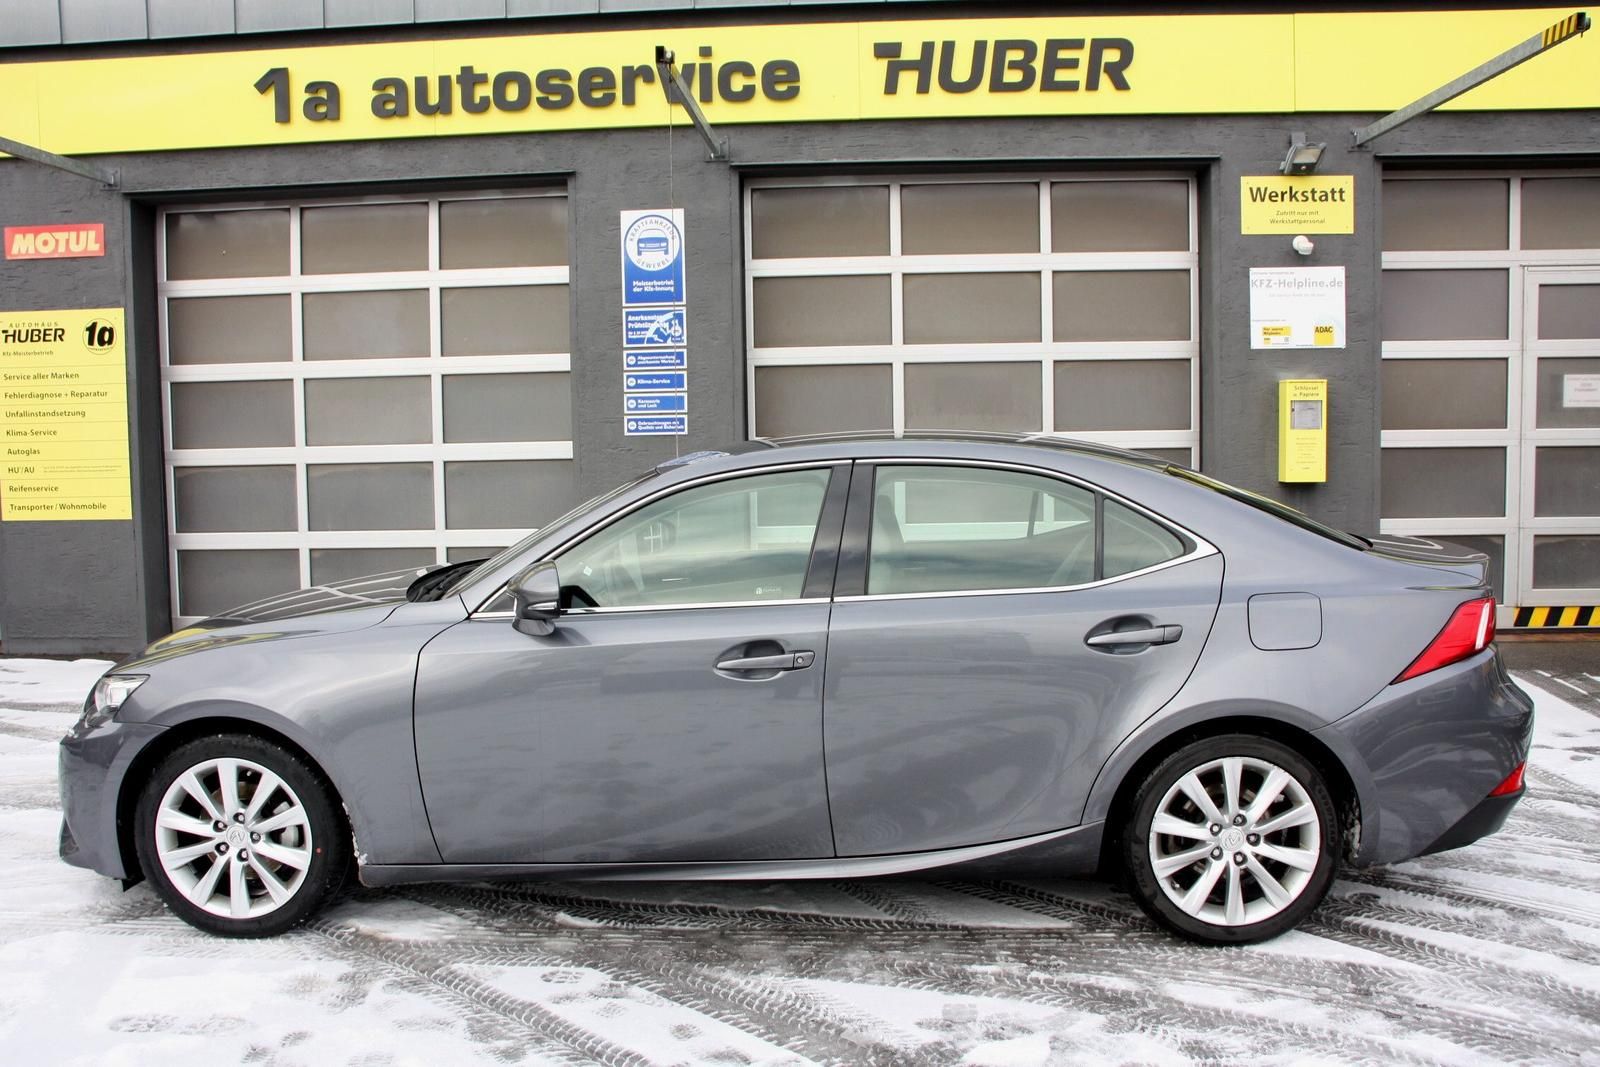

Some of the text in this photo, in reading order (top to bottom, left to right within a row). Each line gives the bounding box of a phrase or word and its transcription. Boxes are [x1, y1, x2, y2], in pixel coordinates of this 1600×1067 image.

[873, 37, 1134, 94] HUBER
[254, 45, 800, 123] 1a autoservice
[1249, 186, 1345, 203] Werkstatt
[11, 230, 100, 255] MOTUL
[1251, 277, 1343, 289] KFZ-Helpline.de
[1, 328, 65, 343] HUBER
[85, 321, 115, 347] 1a
[32, 372, 49, 380] aller
[50, 371, 80, 379] Marken
[4, 391, 63, 400] Fehlerdiagnose
[5, 410, 86, 418] Unfallinstandsetzung
[6, 429, 58, 437] Klima-Service
[7, 448, 41, 456] Autoglas
[8, 485, 60, 493] Reifenservice
[10, 503, 54, 512] Transporter
